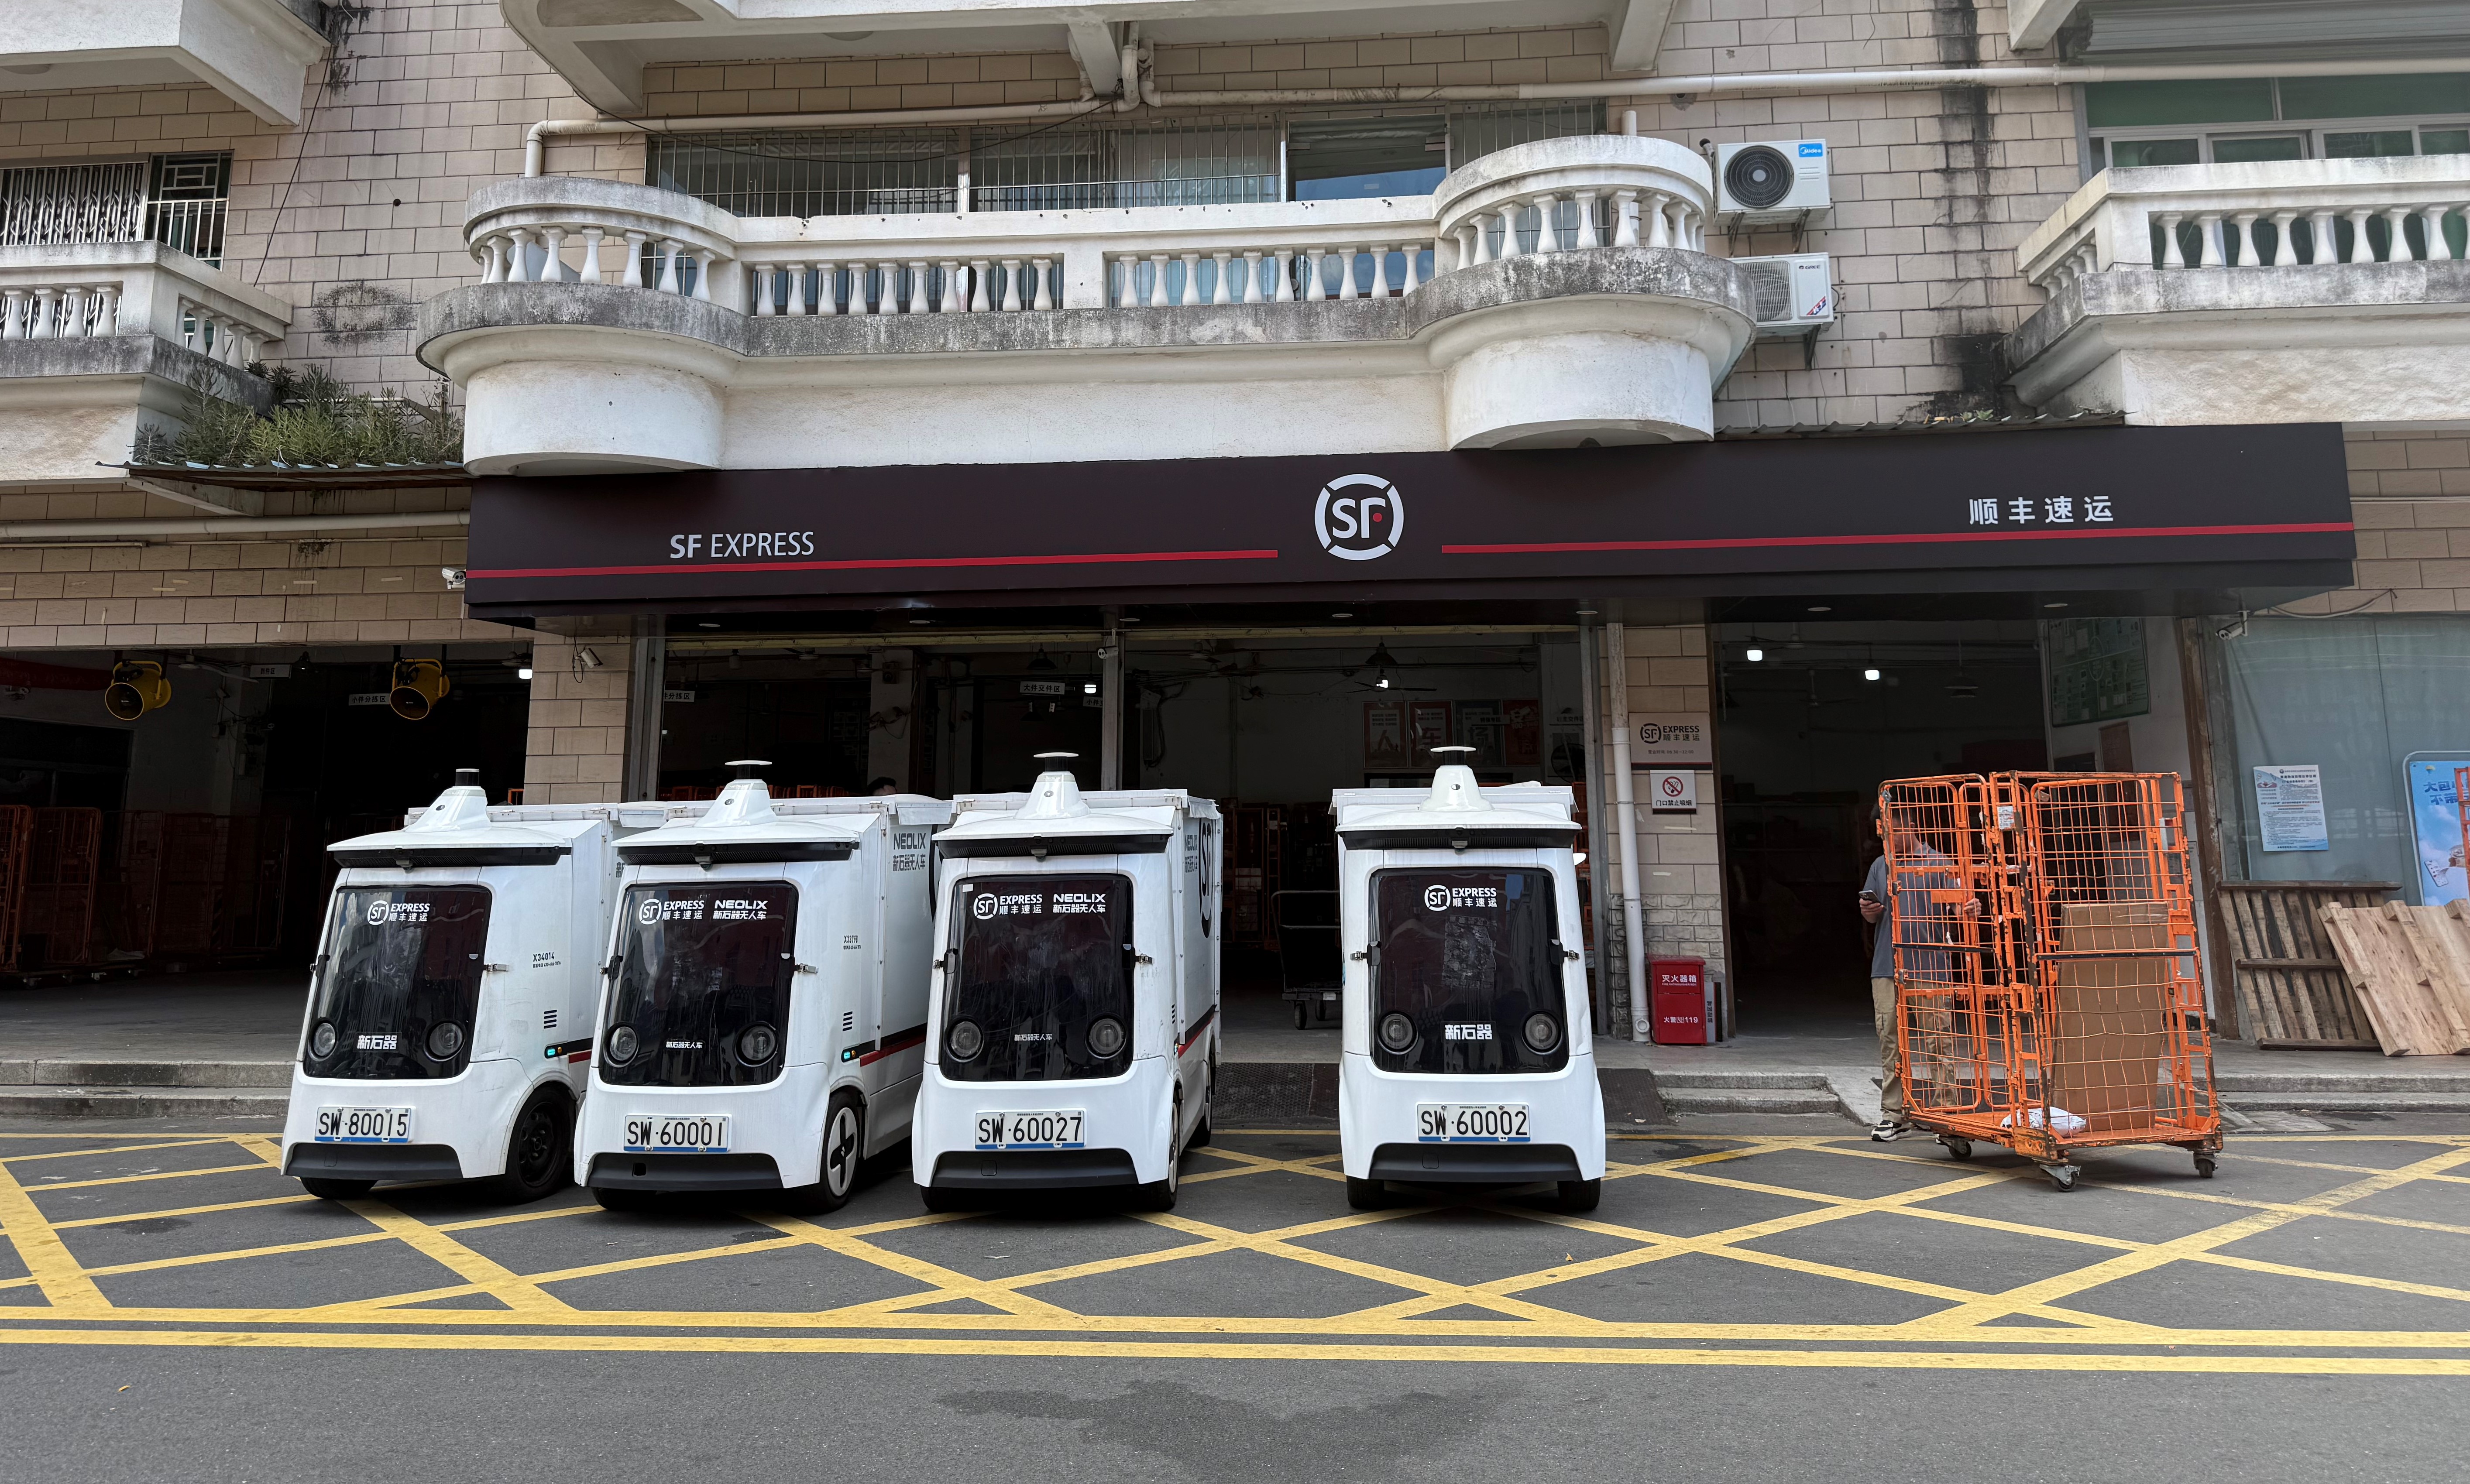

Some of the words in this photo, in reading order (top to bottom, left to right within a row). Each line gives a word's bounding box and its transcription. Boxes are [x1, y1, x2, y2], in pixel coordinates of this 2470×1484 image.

[1969, 496, 2113, 524] 顺丰速运
[670, 534, 702, 559] SF
[711, 531, 814, 558] EXPRESS
[2423, 781, 2455, 792] 大包
[893, 833, 926, 850] NEOLIX
[893, 854, 926, 871] 新石器无人车
[1452, 888, 1497, 897] EXPRESS
[1000, 895, 1042, 905] EXPRESS
[1053, 894, 1106, 903] NEOLIX
[1453, 898, 1497, 907] 顺丰速运
[391, 903, 430, 912] EXPRESS
[663, 900, 705, 910] EXPRESS
[715, 900, 768, 909] NEOLIX
[1053, 904, 1106, 913] 新石器无人车
[661, 910, 703, 920] 顺丰速运
[713, 910, 767, 920] 新石器无人车
[999, 905, 1042, 915] 顺丰速运
[388, 912, 428, 922] 顺丰速运
[533, 952, 554, 962] X34014
[1445, 1024, 1493, 1040] 新石器
[357, 1035, 397, 1050] 新石器
